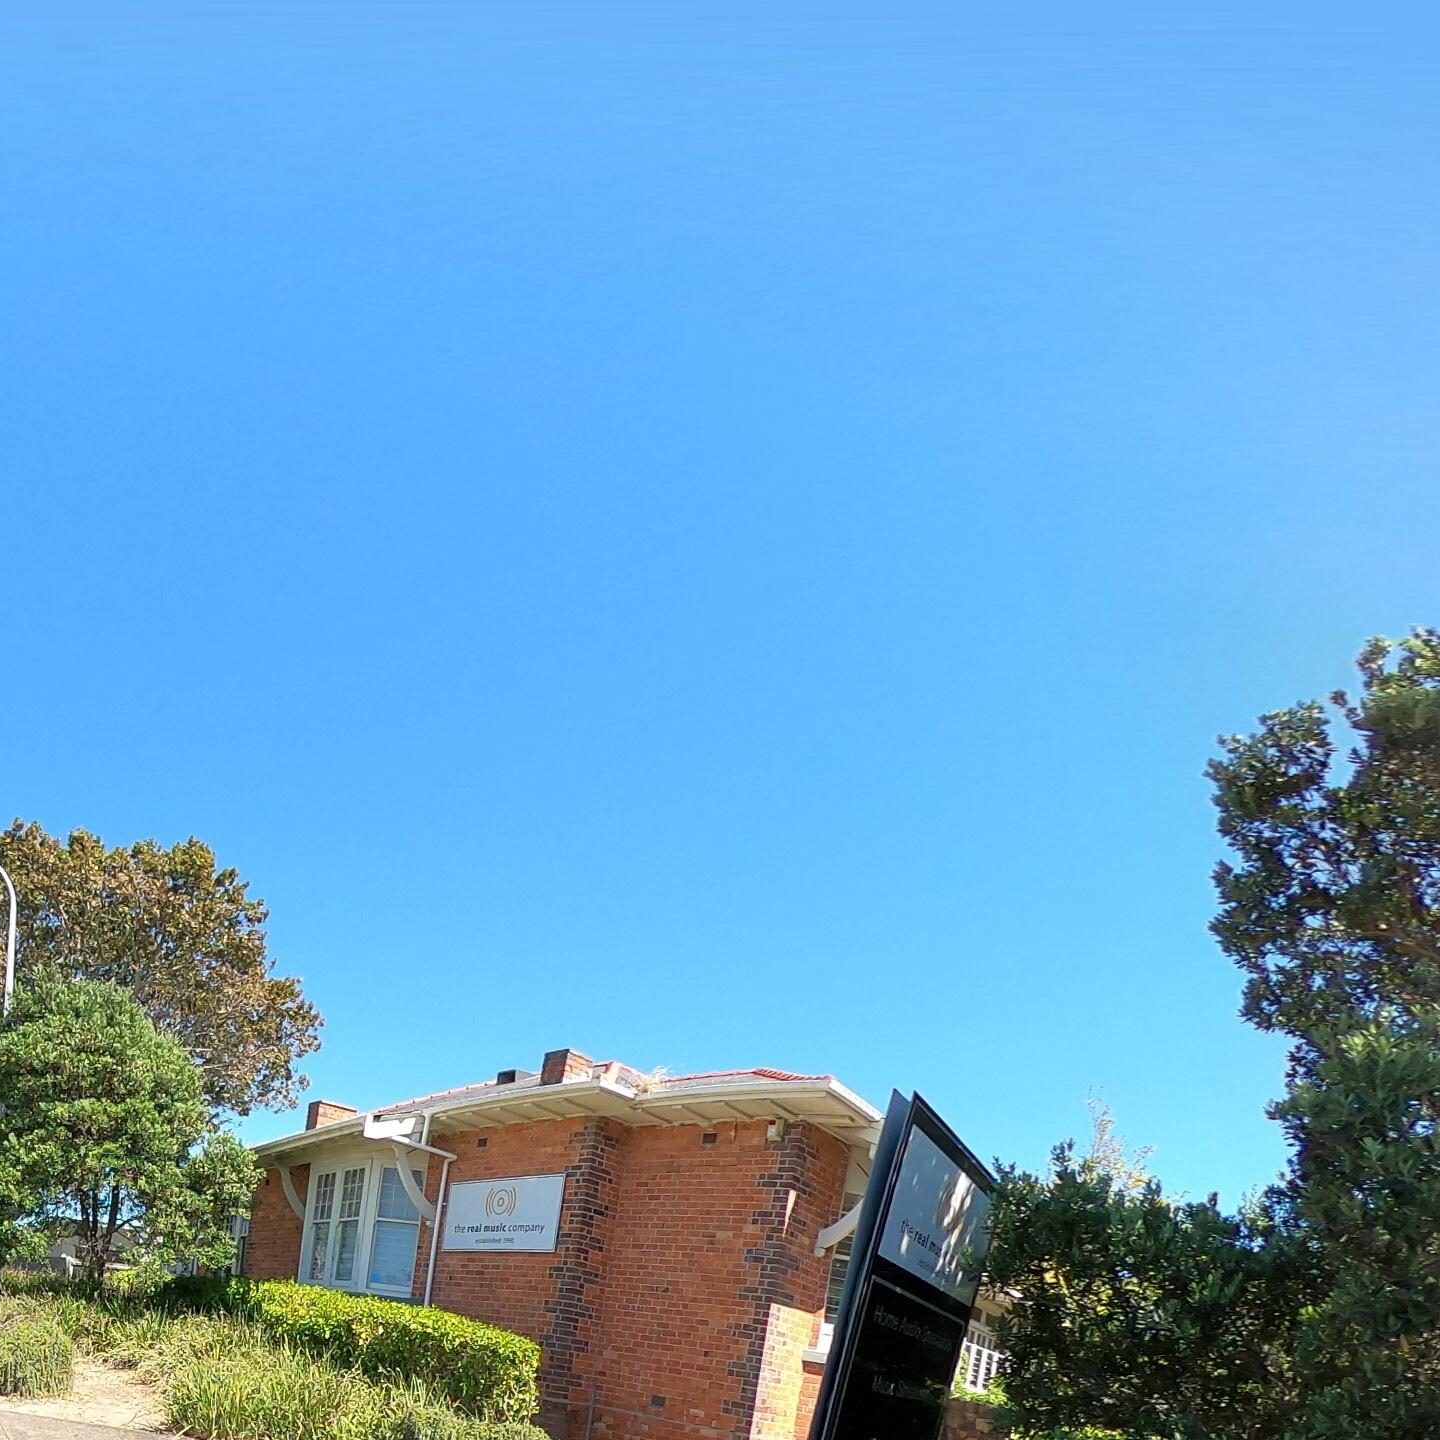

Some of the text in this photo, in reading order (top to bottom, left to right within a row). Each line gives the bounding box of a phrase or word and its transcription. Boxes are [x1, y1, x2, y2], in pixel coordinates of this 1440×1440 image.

[454, 1222, 545, 1235] the real music company
[901, 1218, 930, 1248] the real
